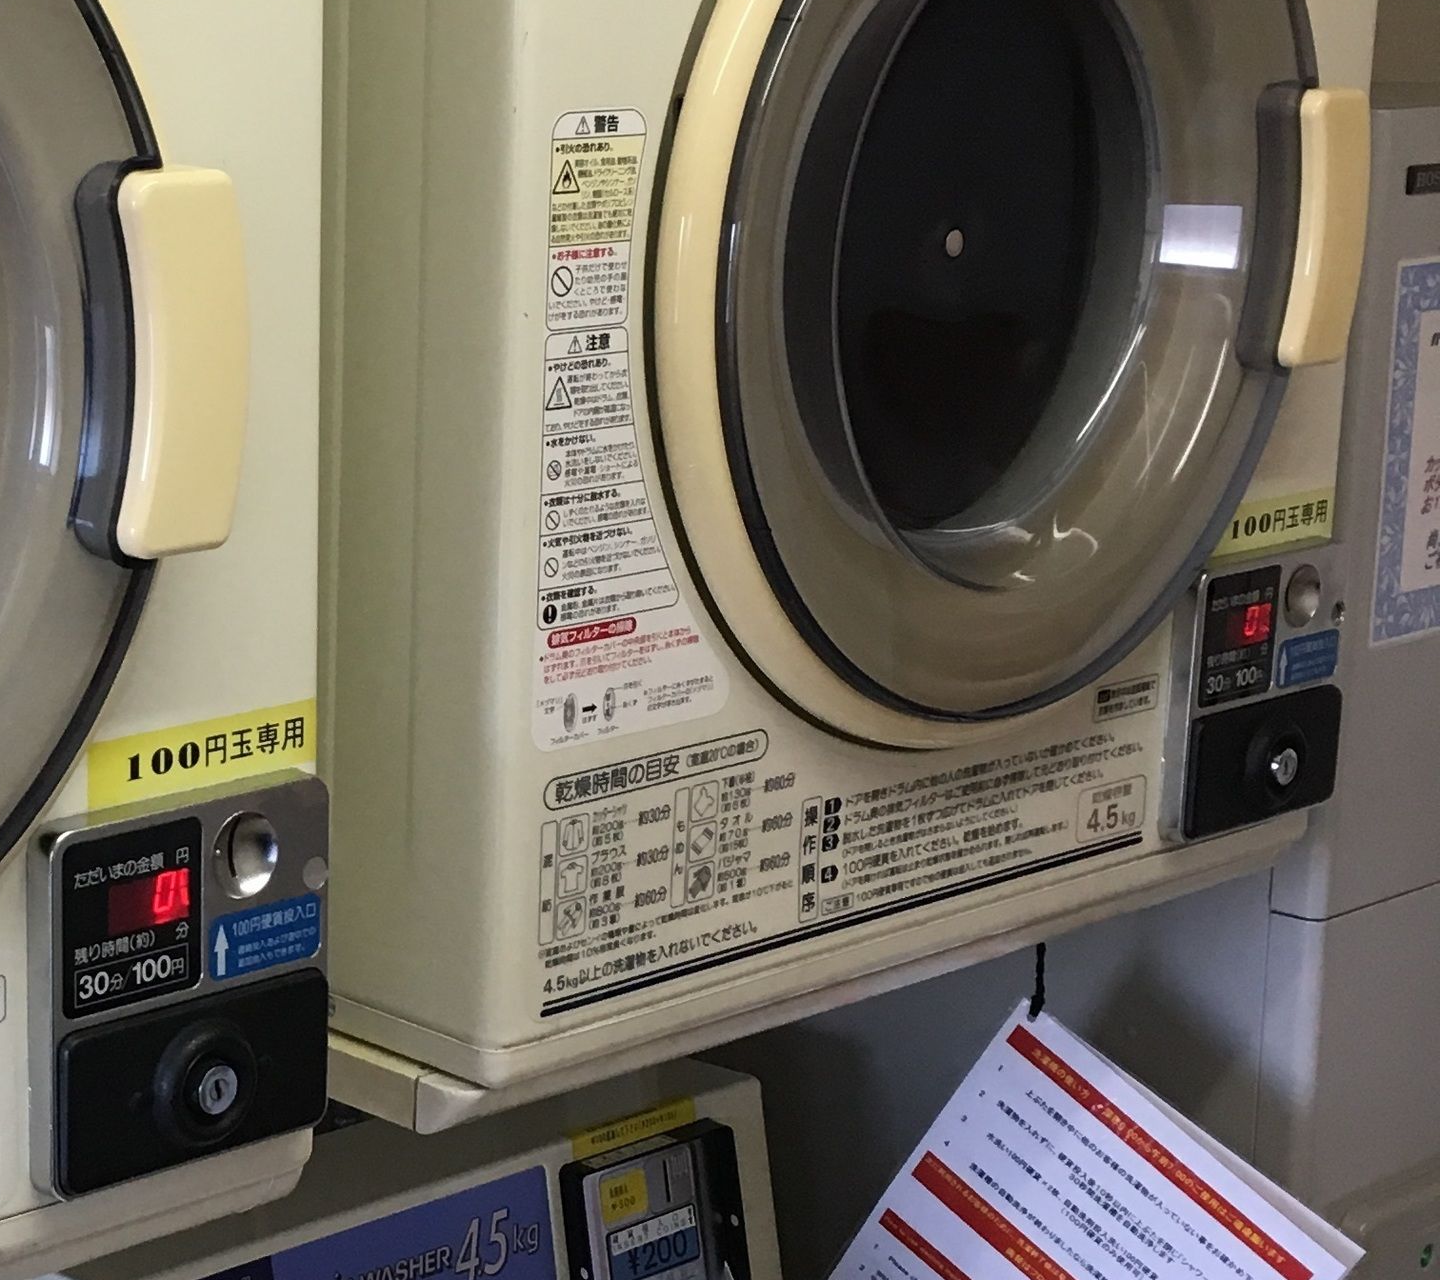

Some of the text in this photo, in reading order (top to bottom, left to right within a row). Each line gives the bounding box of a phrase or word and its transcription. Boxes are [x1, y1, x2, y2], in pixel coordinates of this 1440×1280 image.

[594, 116, 618, 133] 警告
[586, 333, 610, 350] 注意
[1232, 500, 1328, 540] 100円玉専用
[127, 717, 306, 783] 100円玉専用
[556, 755, 680, 804] 乾燥時間の目安
[1087, 804, 1119, 834] 4.5
[74, 847, 189, 890] ただいまの金額 円
[176, 921, 189, 941] 分
[512, 1223, 540, 1253] kg
